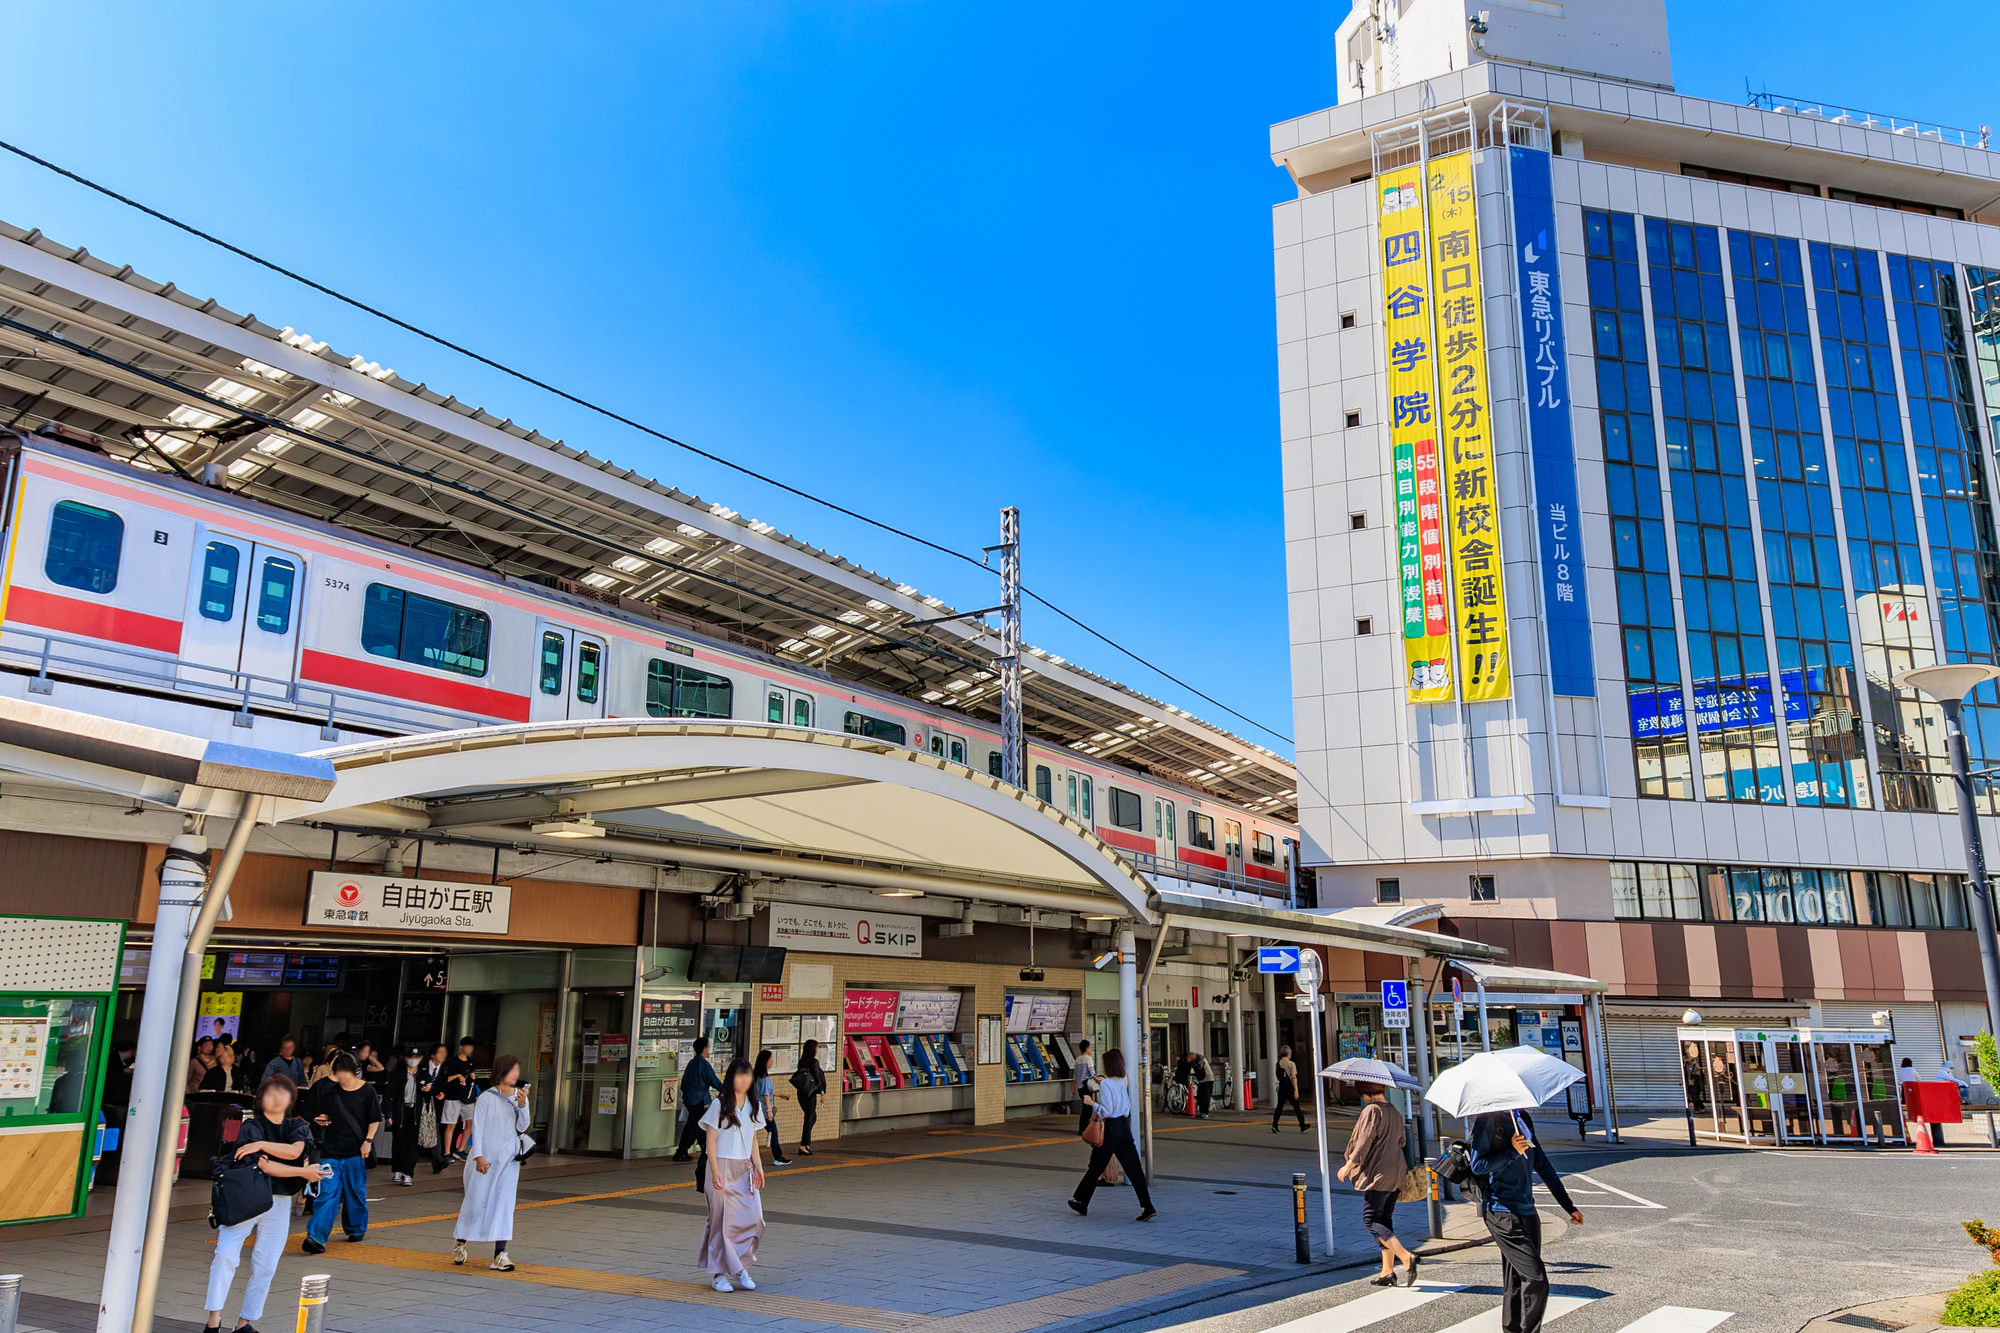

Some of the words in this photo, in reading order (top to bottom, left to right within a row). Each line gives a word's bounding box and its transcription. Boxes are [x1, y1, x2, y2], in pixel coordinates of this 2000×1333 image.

[1385, 230, 1432, 429] 四谷学院
[1528, 270, 1561, 409] 東急リバブル
[157, 532, 166, 544] 3
[1396, 456, 1423, 624] 科目別能力別授業
[1416, 453, 1445, 622] 55段階個別指導
[1549, 503, 1574, 603] 当ビル8階
[324, 577, 351, 592] 5374
[382, 883, 493, 914] 自由が丘駅
[323, 908, 369, 921] 東急電鉄
[399, 912, 452, 927] Jiyūgaoka
[455, 915, 474, 927] Sta.
[874, 931, 917, 946] SKIP
[643, 1016, 677, 1027] 自由が丘駅
